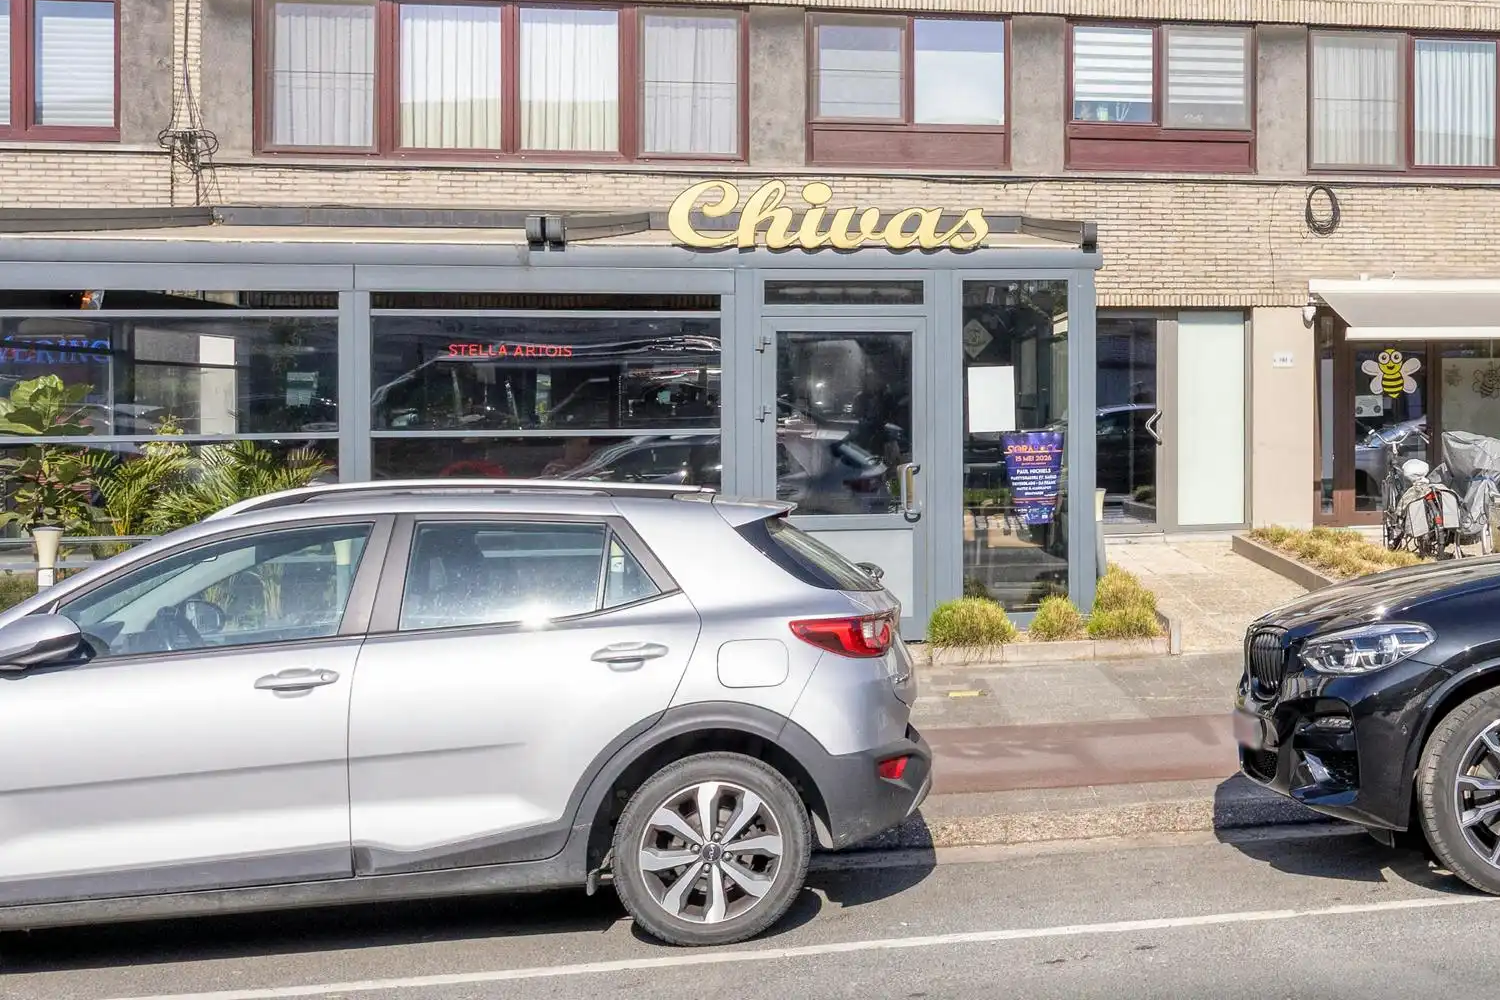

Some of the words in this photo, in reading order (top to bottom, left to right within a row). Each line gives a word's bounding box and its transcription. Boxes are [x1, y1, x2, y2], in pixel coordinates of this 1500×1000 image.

[668, 179, 989, 248] Chivas
[448, 343, 508, 358] STELLA
[513, 344, 573, 357] ARTOIS
